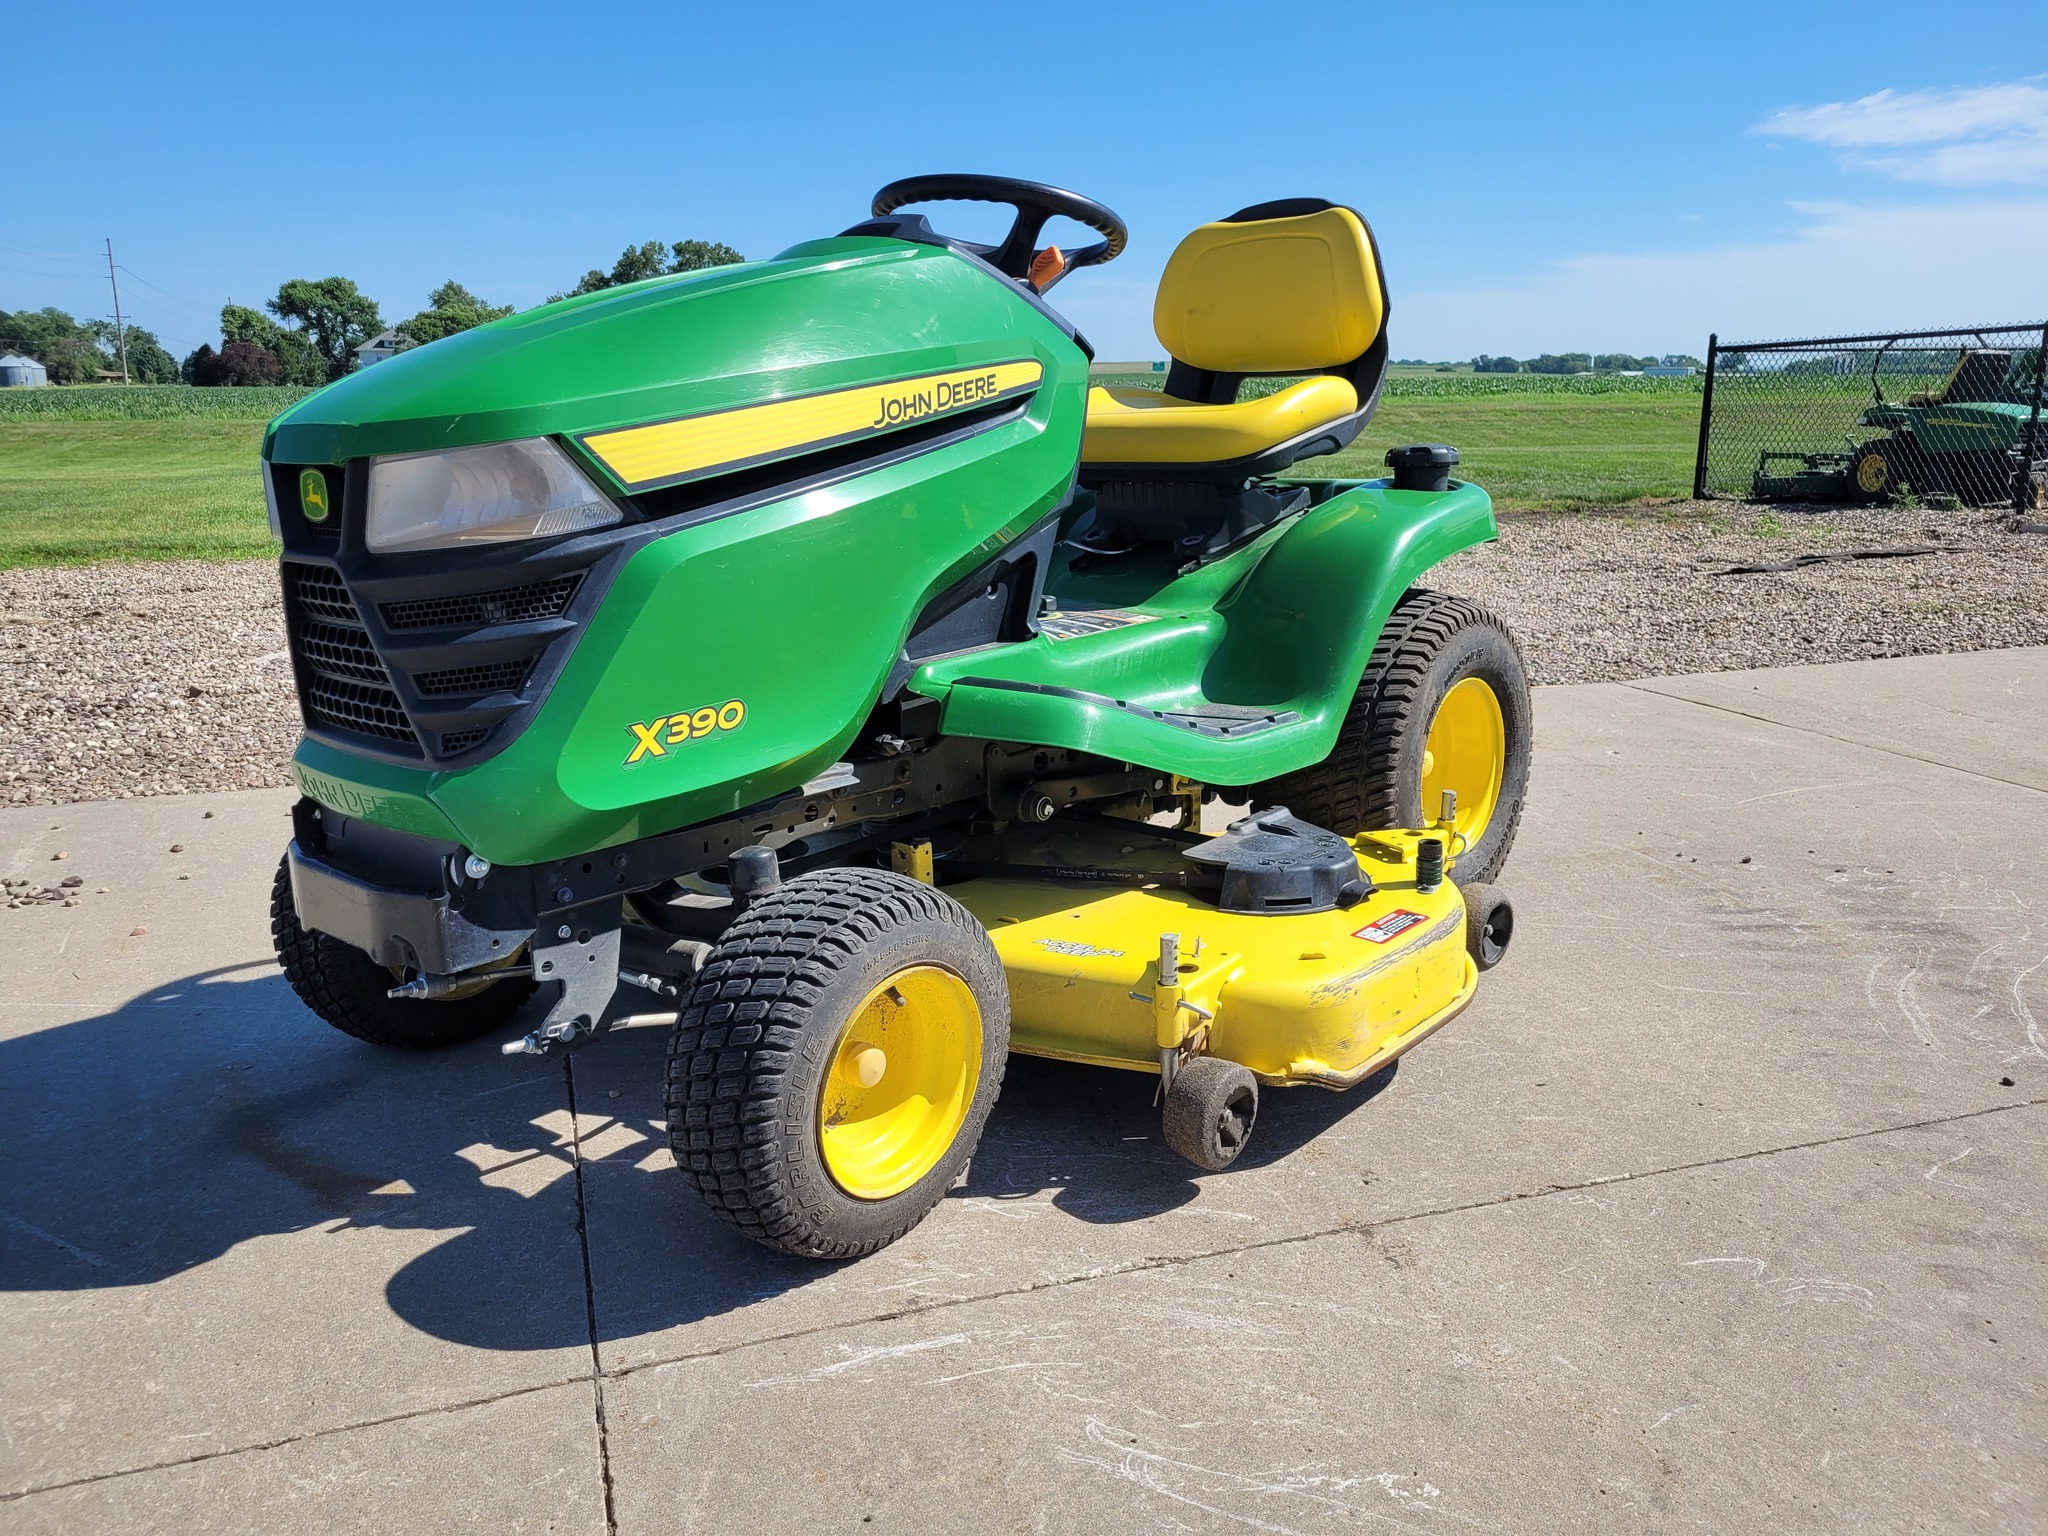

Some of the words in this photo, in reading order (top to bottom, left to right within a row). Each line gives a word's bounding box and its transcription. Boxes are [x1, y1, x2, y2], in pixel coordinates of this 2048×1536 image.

[873, 390, 931, 426] JOHN
[936, 373, 998, 409] DEERE
[623, 699, 745, 764] X390
[297, 766, 342, 808] JOHN
[1033, 938, 1096, 951] ACCEL
[1044, 946, 1098, 957] DEEP
[785, 1031, 837, 1227] CARLISLE
